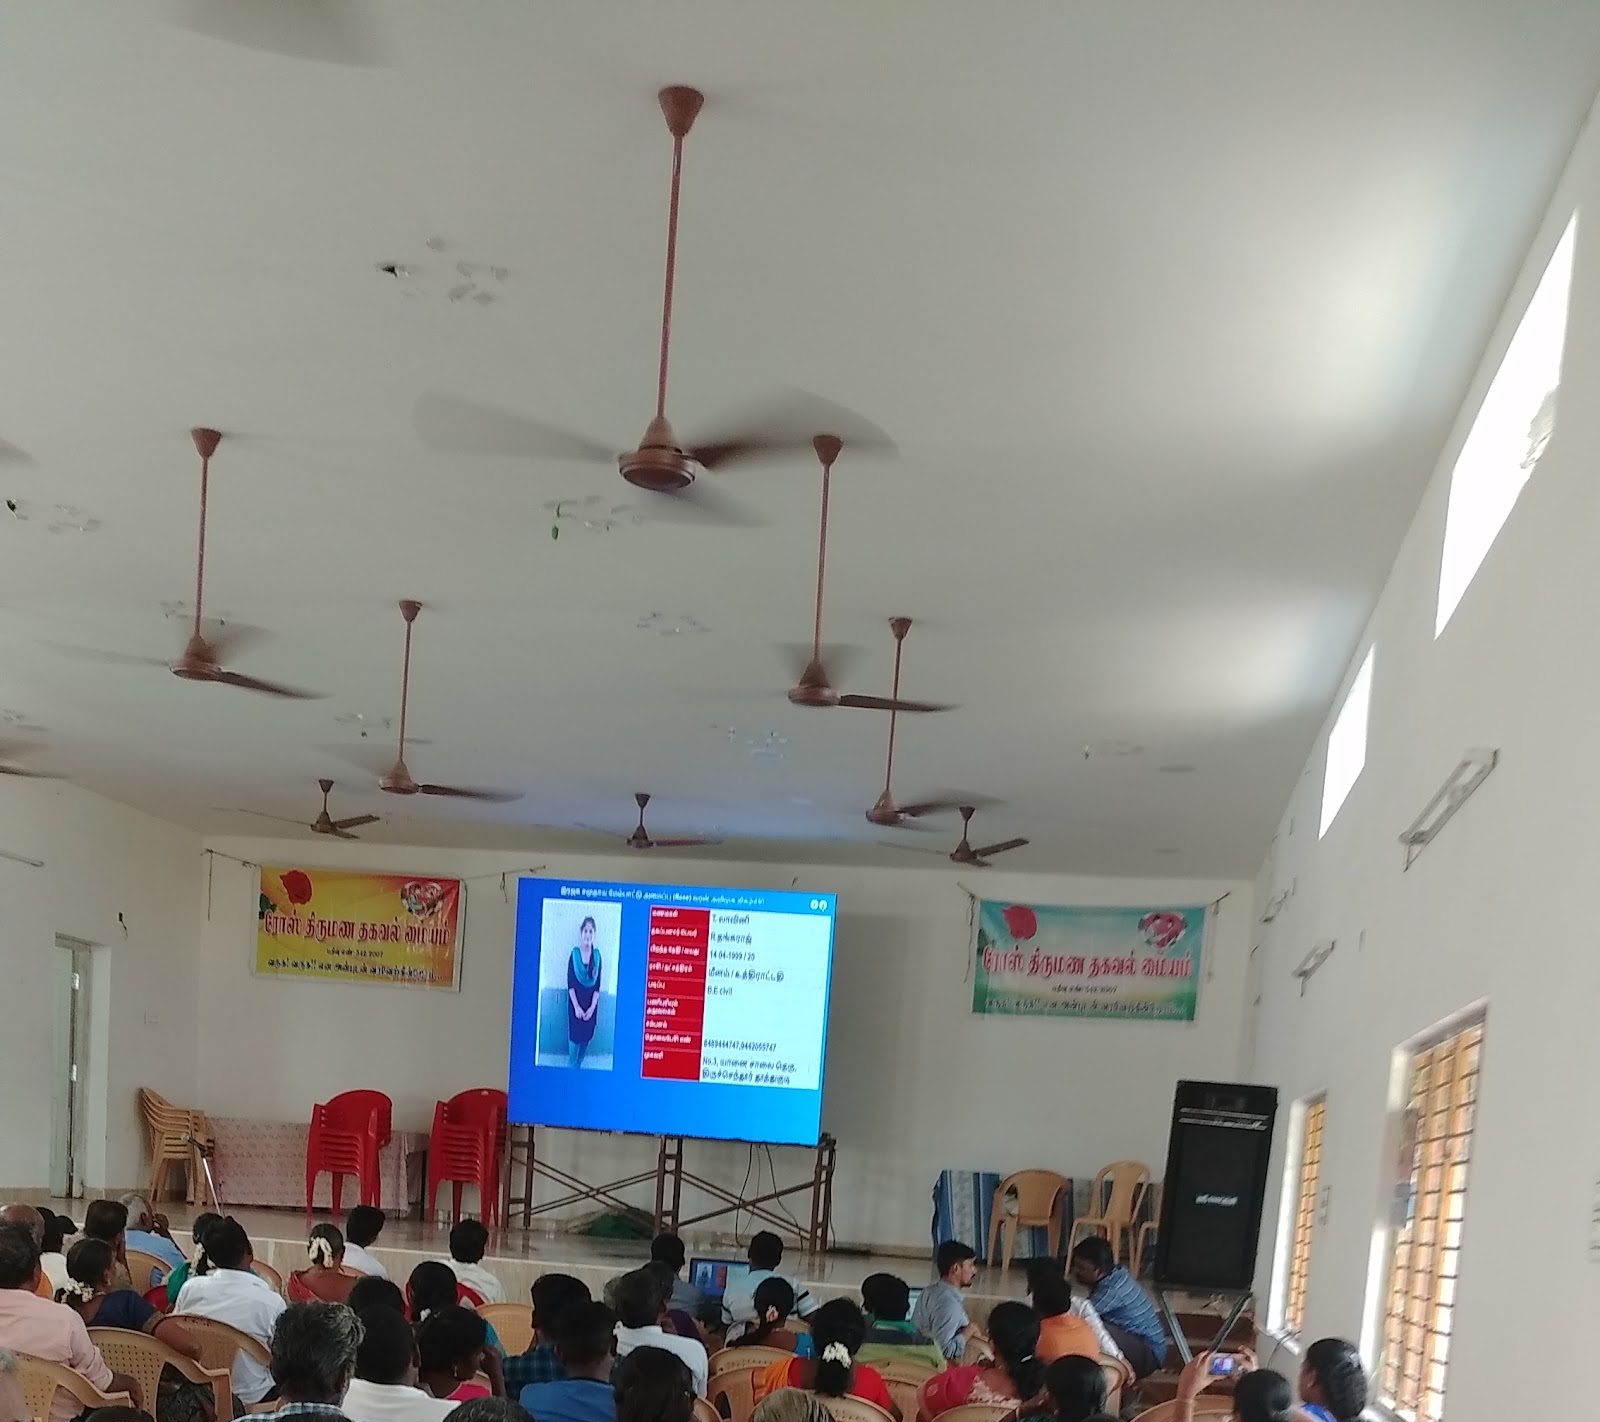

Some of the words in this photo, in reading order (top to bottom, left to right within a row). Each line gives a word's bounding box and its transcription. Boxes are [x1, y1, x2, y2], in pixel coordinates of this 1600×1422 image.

[265, 909, 302, 936] ரோஸ்
[304, 911, 356, 942] திருமண
[358, 917, 402, 942] தகவல்
[404, 921, 450, 945] மையம்
[982, 944, 1024, 972] ரோஸ்
[1027, 946, 1085, 978] திருமண
[1087, 950, 1136, 978] தகவல்
[1141, 951, 1193, 977] மையம்
